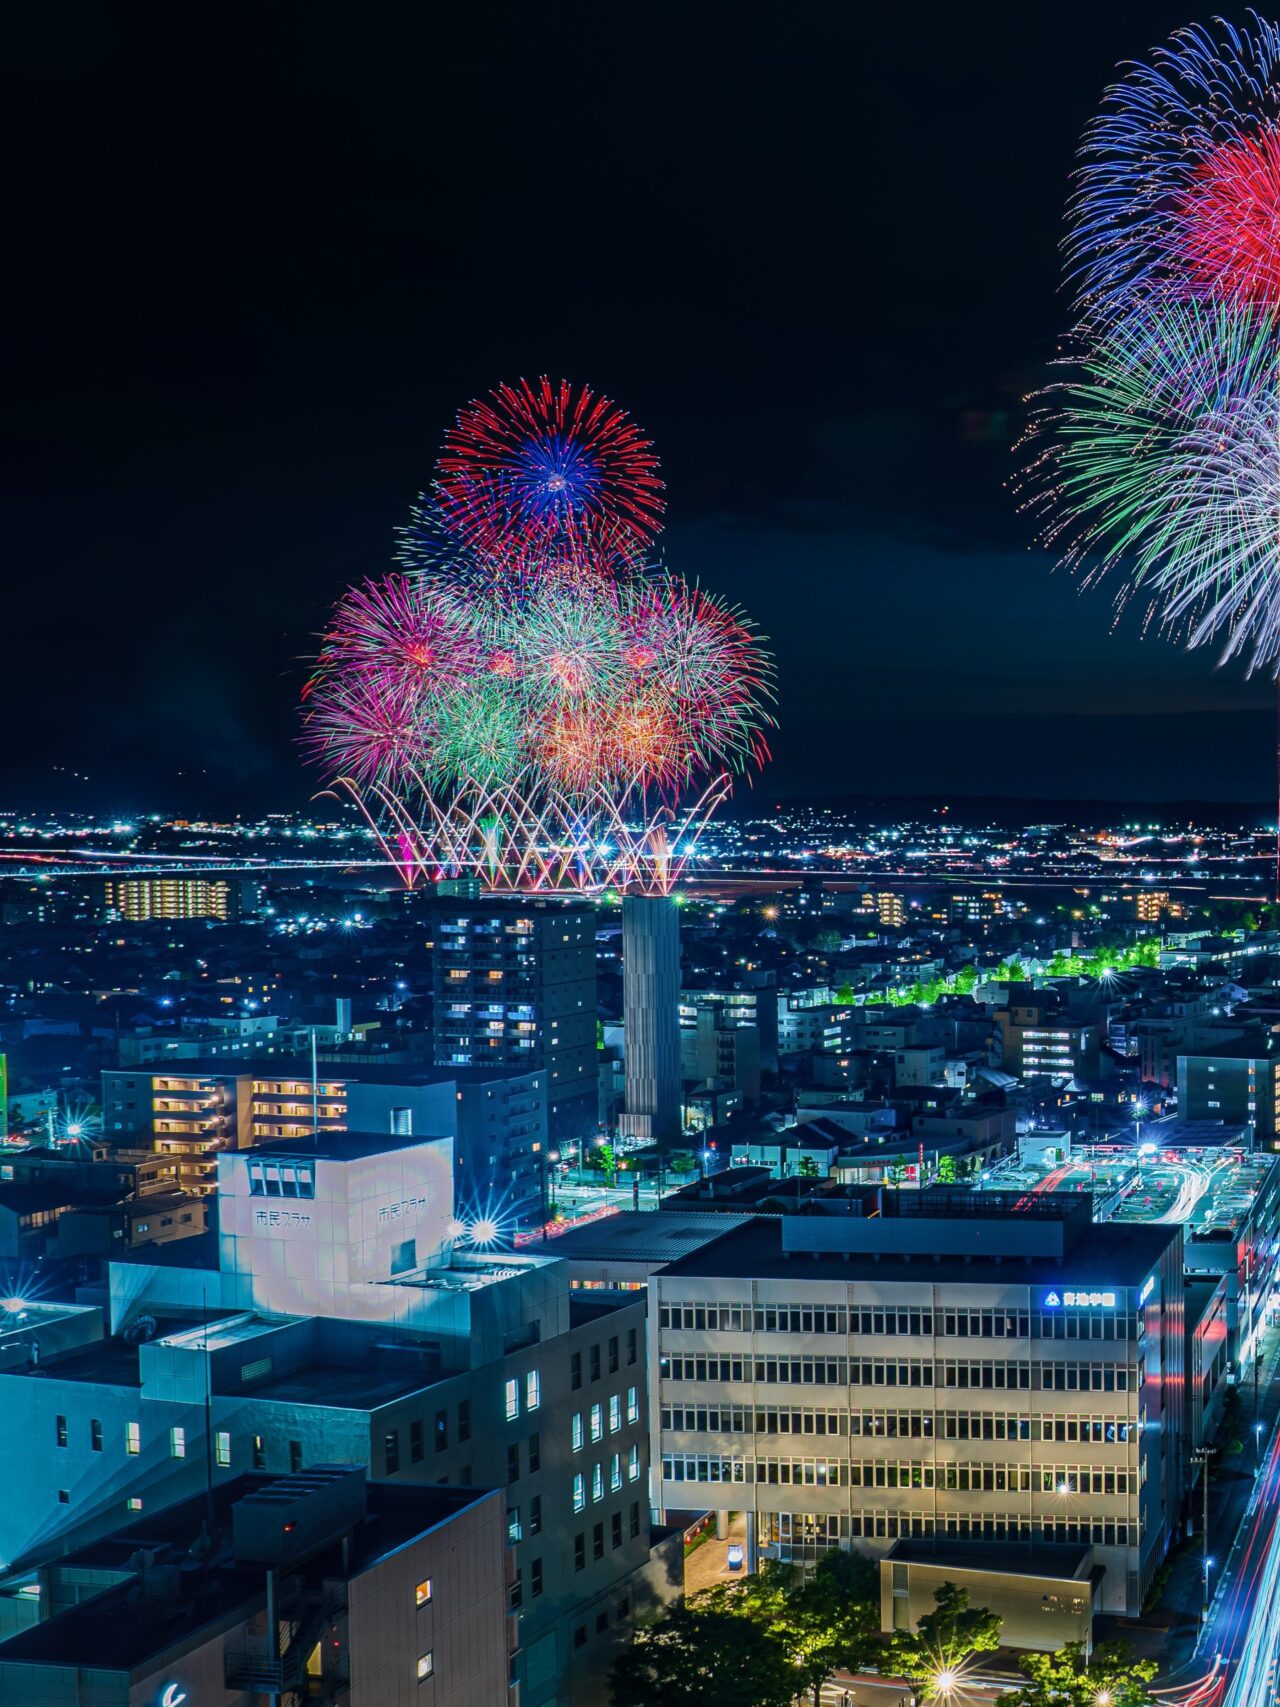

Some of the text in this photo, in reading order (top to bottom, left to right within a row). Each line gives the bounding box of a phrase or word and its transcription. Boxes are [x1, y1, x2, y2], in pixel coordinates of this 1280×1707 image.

[256, 1211, 312, 1230] 市民プラザ
[379, 1198, 427, 1222] 市民プラザ
